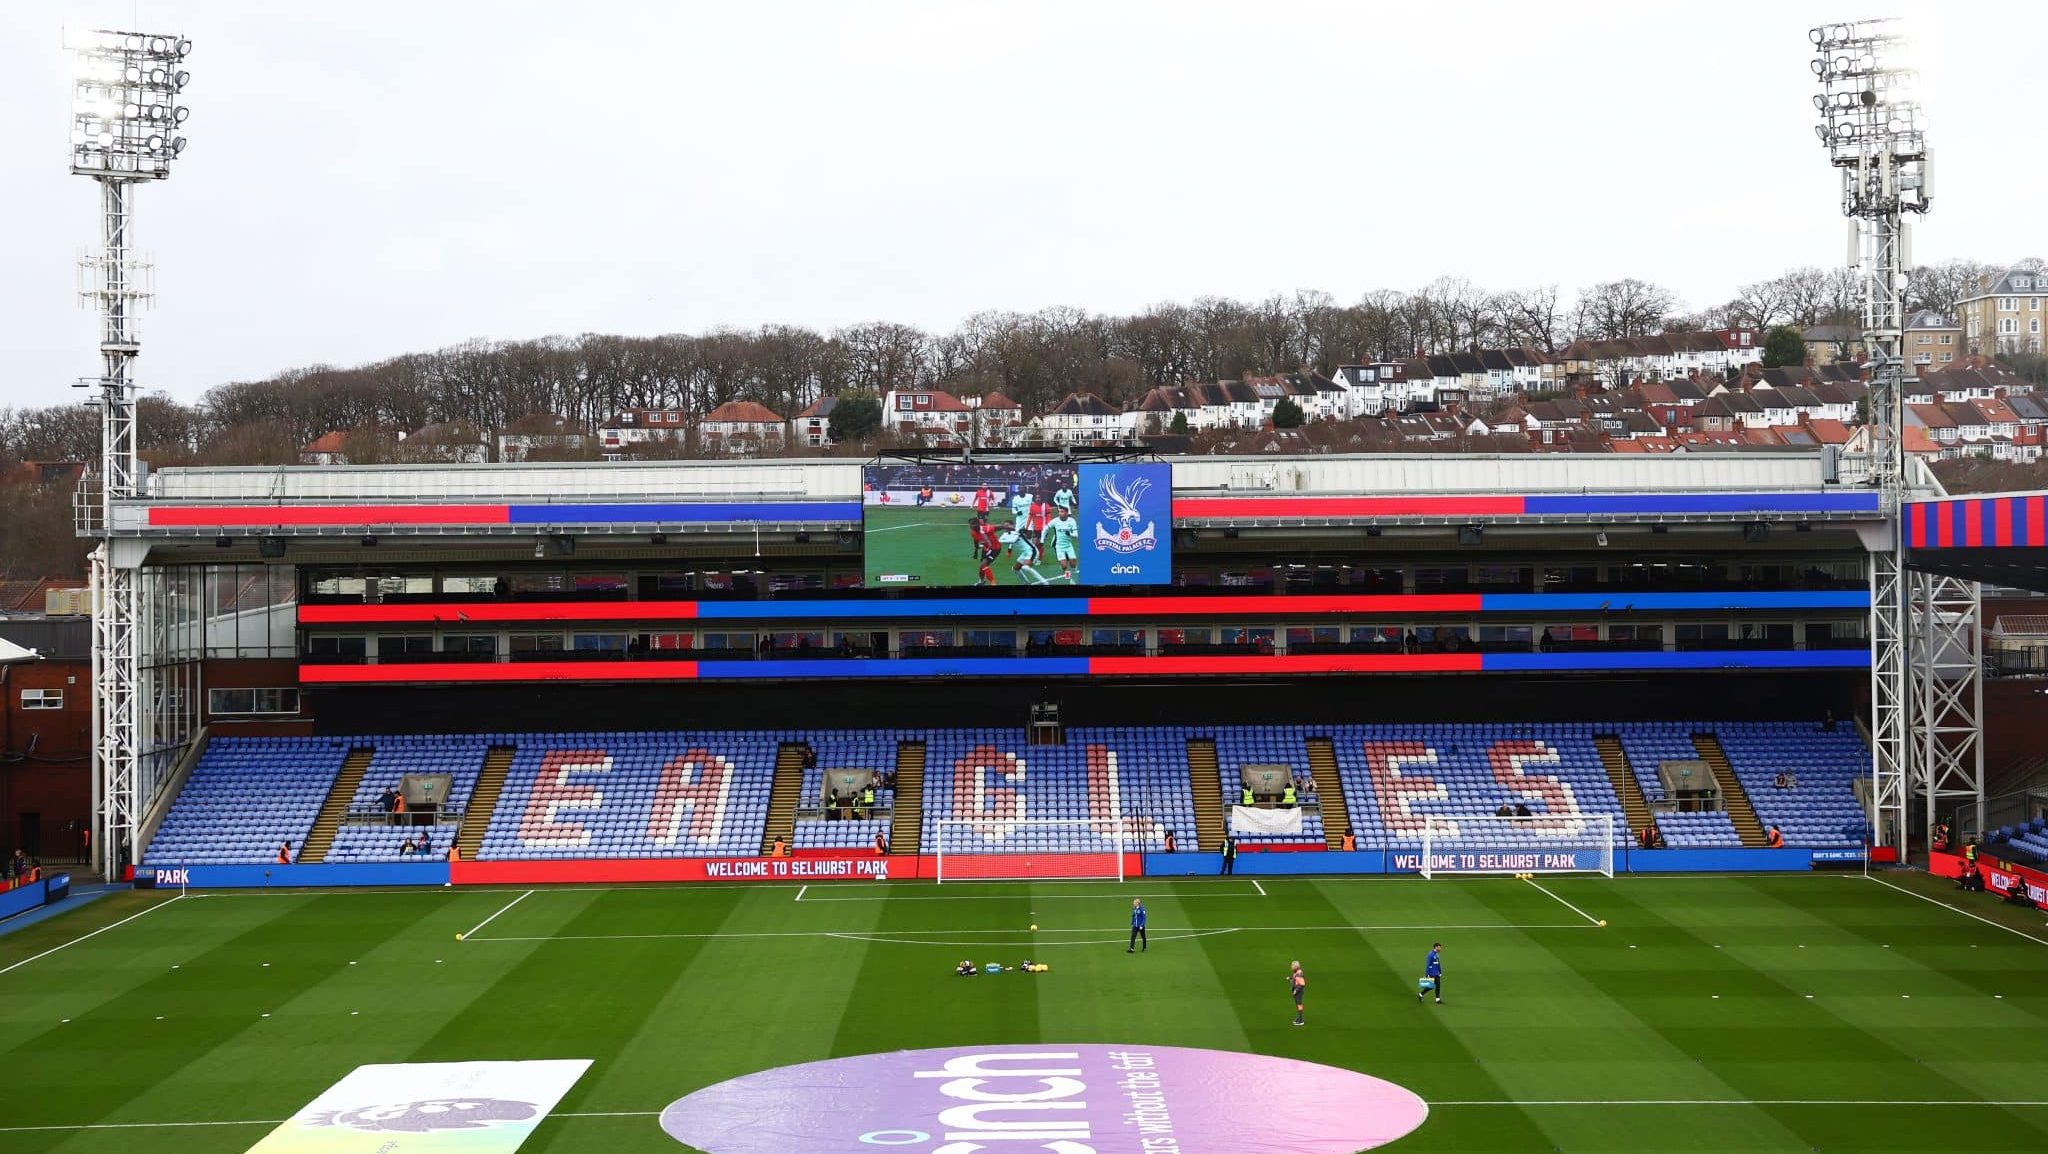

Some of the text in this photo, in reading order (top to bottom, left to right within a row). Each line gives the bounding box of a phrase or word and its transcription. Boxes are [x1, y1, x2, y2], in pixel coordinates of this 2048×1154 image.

[1098, 540, 1121, 551] CRYSTAL
[1122, 540, 1143, 552] PALACE
[1111, 563, 1140, 574] cinch
[706, 860, 889, 876] WELCOME TO SELHURST PARK
[1395, 854, 1576, 869] WELOME TO SELHURST PARK
[156, 869, 190, 884] PARK
[1108, 1051, 1155, 1070] faff
[1116, 1072, 1161, 1088] the
[1123, 1091, 1174, 1134] without
